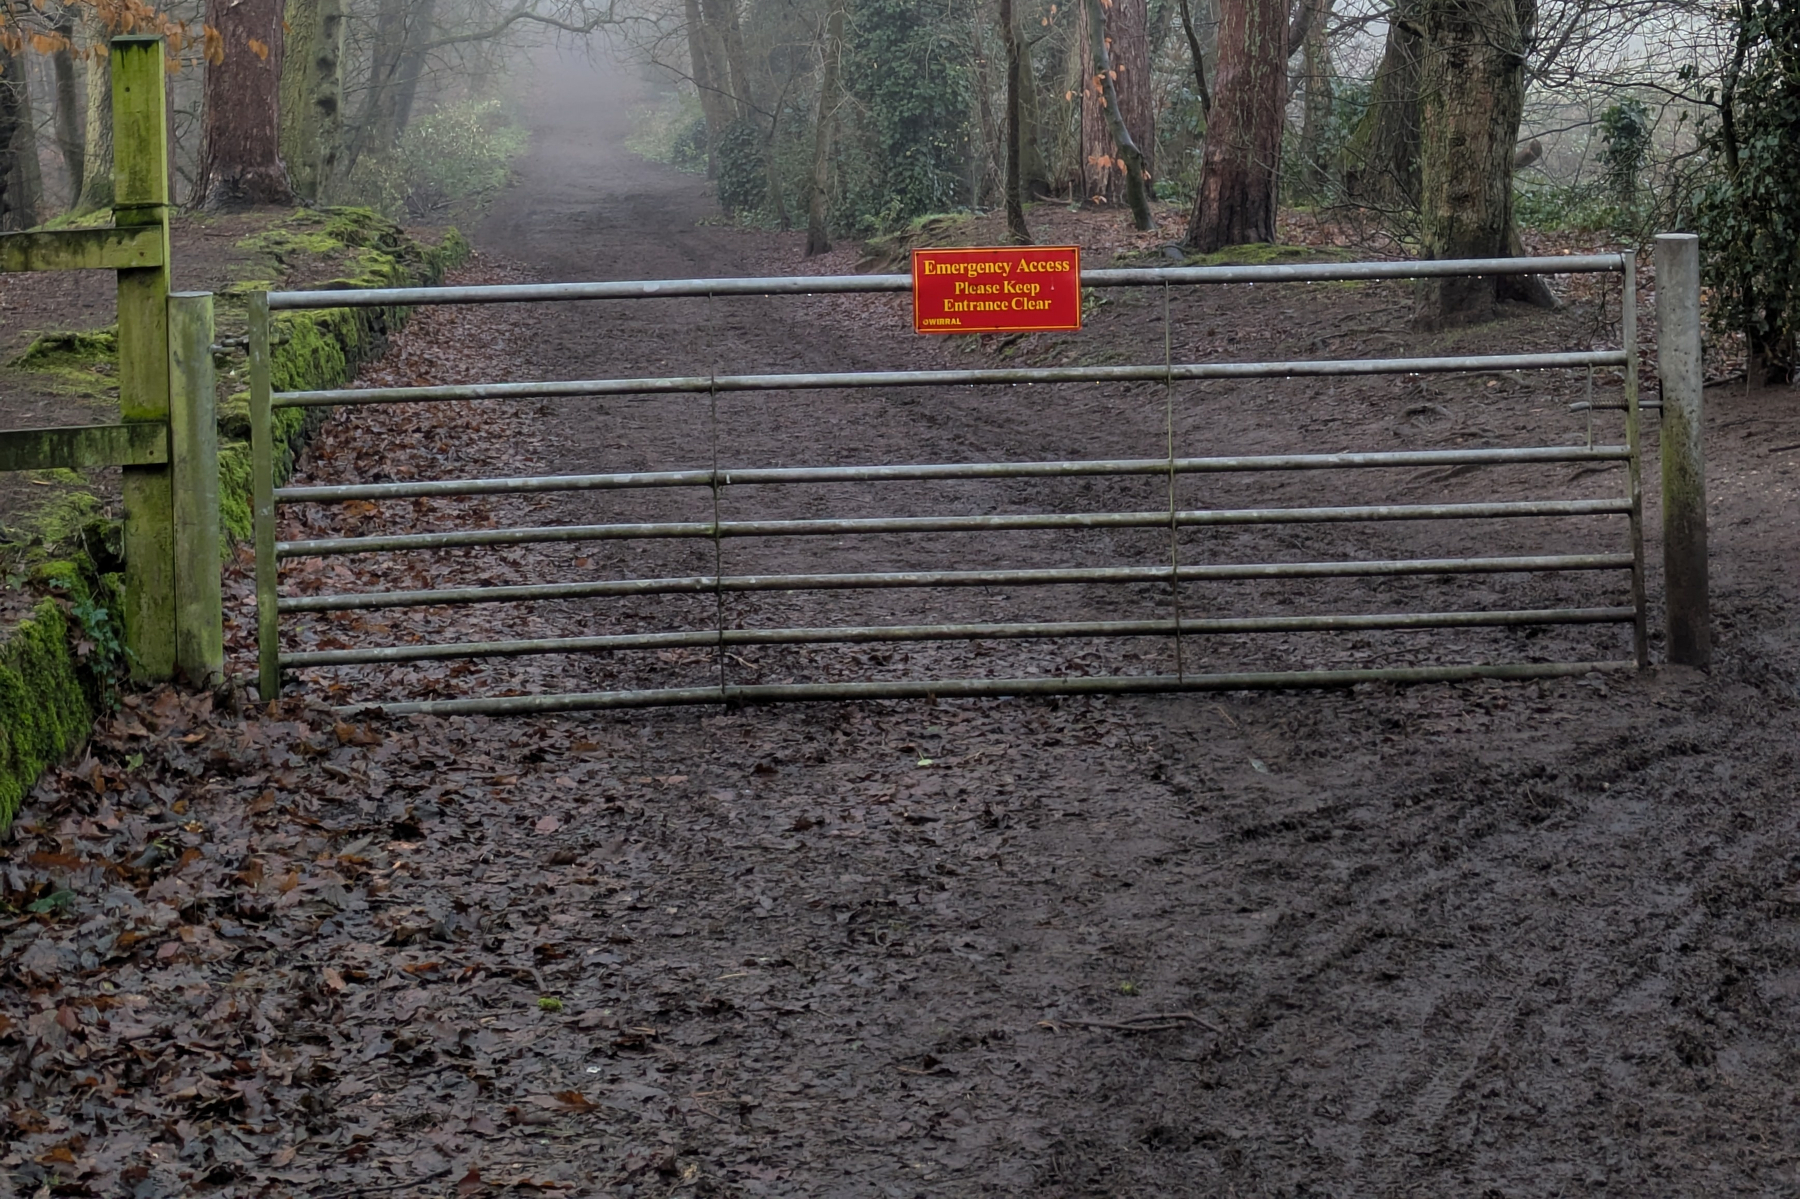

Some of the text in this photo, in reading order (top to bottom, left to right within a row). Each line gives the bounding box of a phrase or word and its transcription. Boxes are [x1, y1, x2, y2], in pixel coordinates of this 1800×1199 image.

[923, 258, 1070, 277] Emergency Access
[954, 280, 1040, 296] Please Keep
[943, 297, 1052, 312] Entrance Clear
